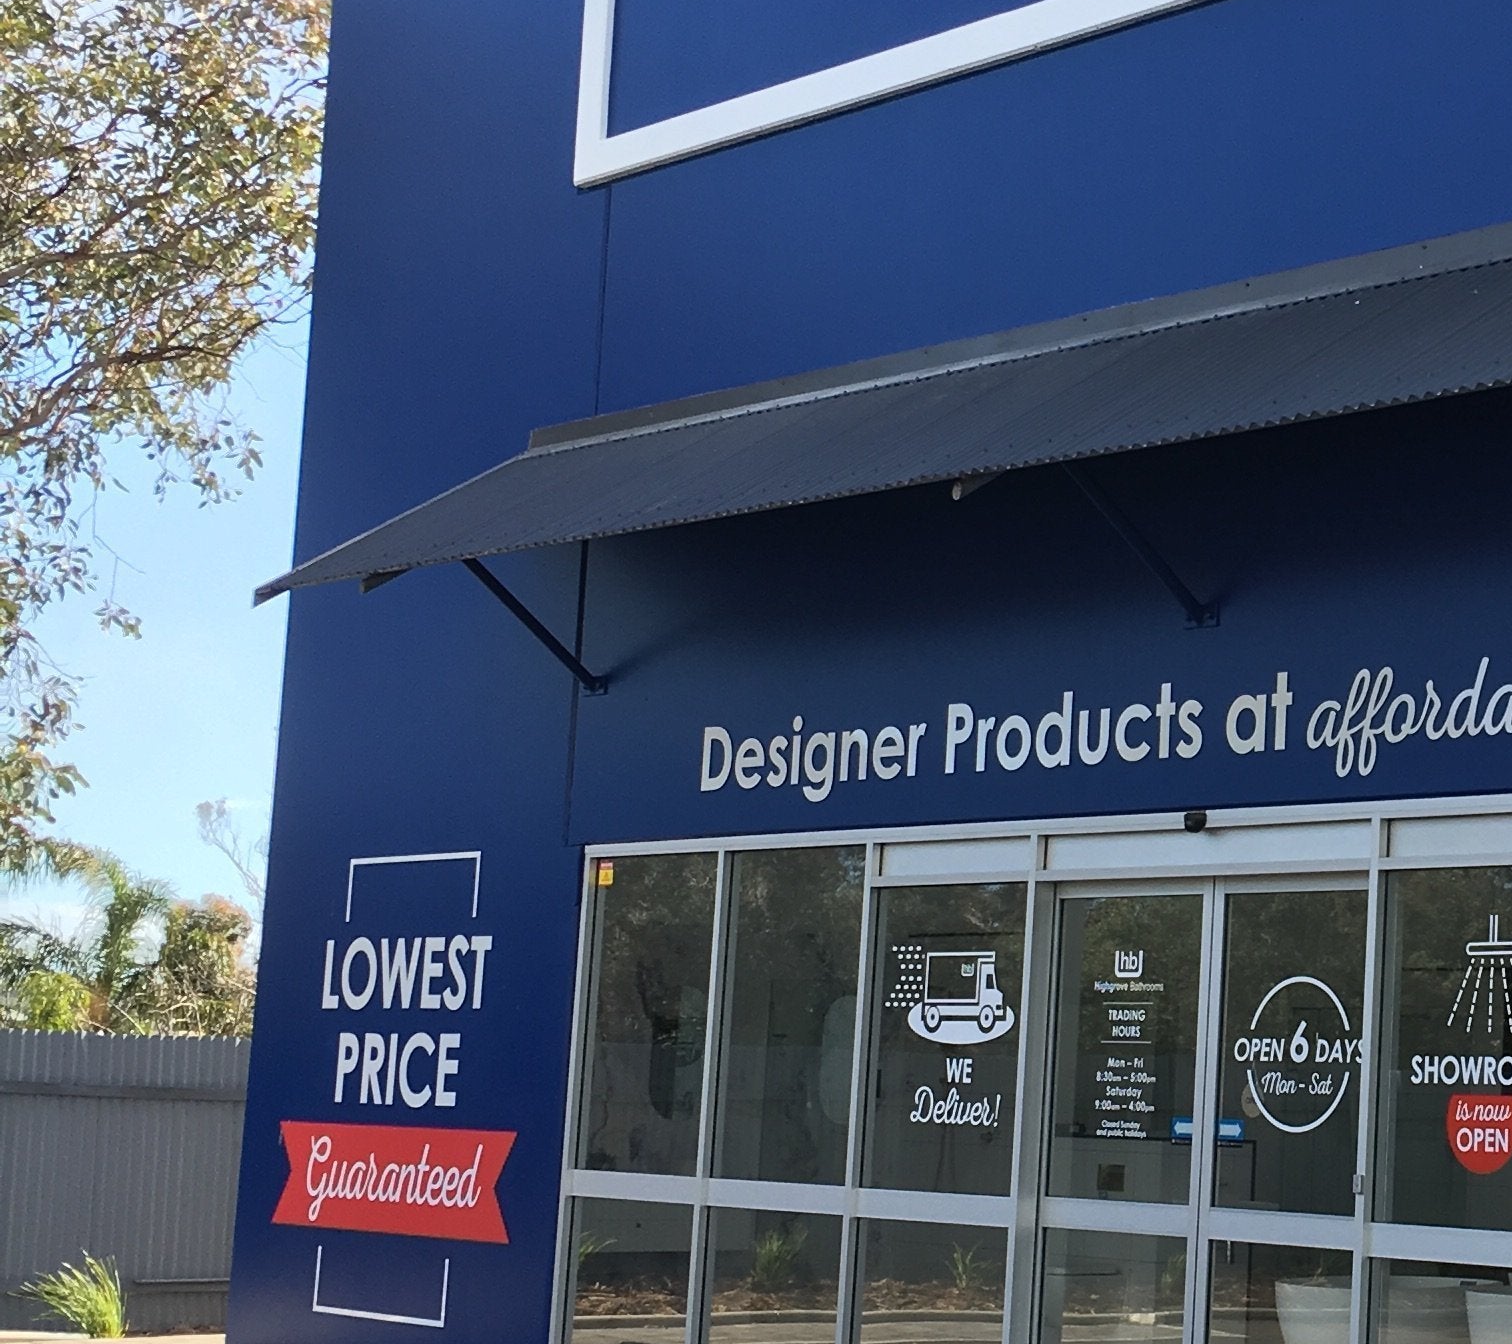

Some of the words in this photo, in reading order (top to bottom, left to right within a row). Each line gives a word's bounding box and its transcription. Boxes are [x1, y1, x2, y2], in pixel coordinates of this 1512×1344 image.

[700, 716, 928, 802] Designer
[944, 683, 1203, 774] Products
[1226, 672, 1293, 755] at
[321, 934, 493, 1011] LOWEST
[1094, 981, 1129, 994] Highgrove
[1129, 981, 1164, 992] Bathrooms
[1108, 1009, 1146, 1022] TRADING
[1112, 1025, 1141, 1038] HOURS
[1233, 1037, 1286, 1062] OPEN
[1289, 1020, 1310, 1064] 6
[334, 1032, 461, 1108] PRICE
[945, 1057, 973, 1084] WE
[1107, 1057, 1126, 1068] Mon
[1133, 1057, 1144, 1069] Fri
[1105, 1085, 1143, 1099] Saturday
[1260, 1071, 1298, 1096] Mon
[1308, 1071, 1334, 1095] Sat
[909, 1085, 1001, 1128] Deliver!
[1455, 1099, 1473, 1121] is
[1473, 1103, 1512, 1122] now
[1120, 1120, 1141, 1130] Sunday
[1456, 1127, 1510, 1153] OPEN
[306, 1135, 482, 1222] Guaranteed
